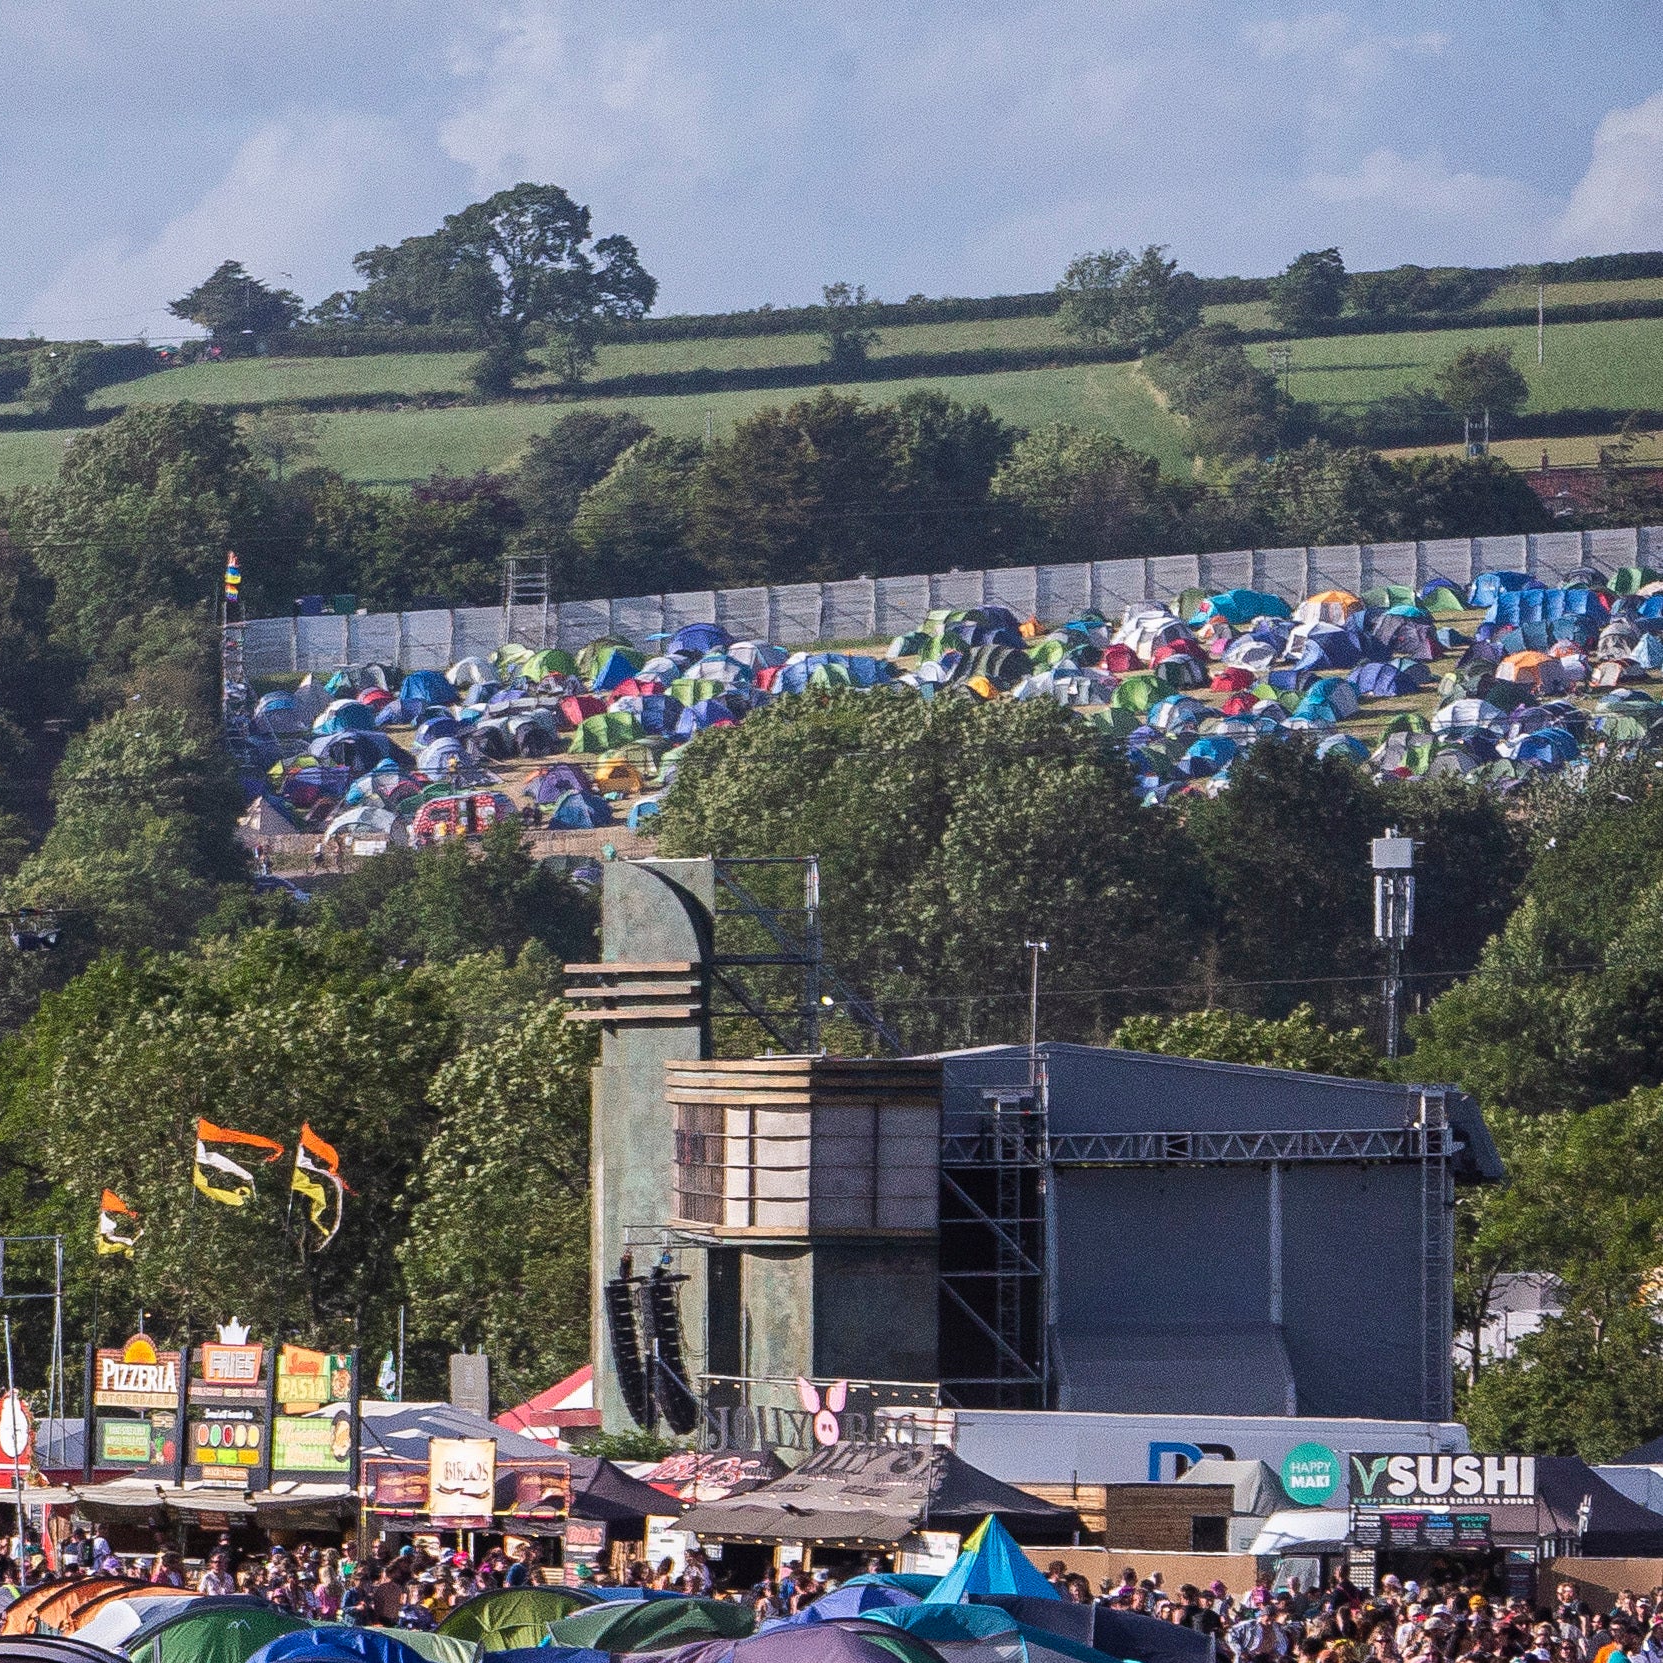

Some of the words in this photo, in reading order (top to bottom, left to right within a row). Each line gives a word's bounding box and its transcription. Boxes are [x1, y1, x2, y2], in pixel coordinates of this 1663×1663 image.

[101, 1357, 177, 1393] PIZZERIA
[281, 1379, 327, 1399] PASTA
[1291, 1461, 1331, 1473] HAPPY
[1291, 1475, 1330, 1488] MAKI
